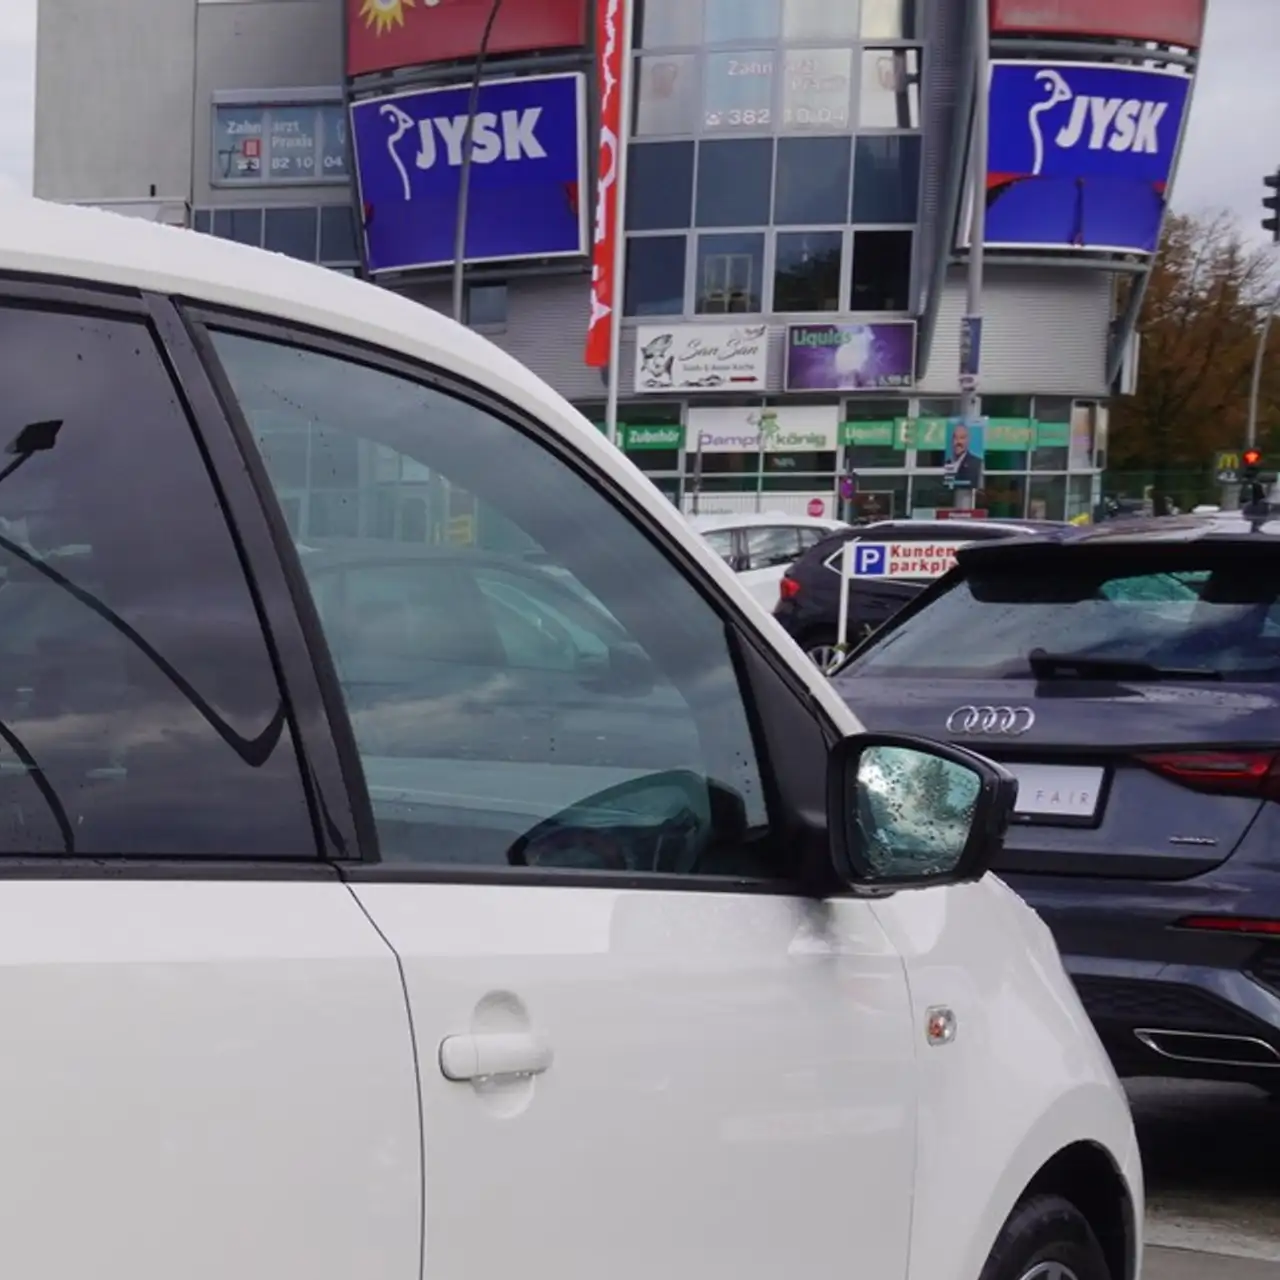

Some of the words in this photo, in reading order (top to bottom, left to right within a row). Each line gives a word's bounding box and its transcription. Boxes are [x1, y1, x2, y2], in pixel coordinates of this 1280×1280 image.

[727, 60, 773, 76] Zahn
[728, 109, 770, 125] 382
[1053, 95, 1168, 154] JYSK
[227, 121, 262, 135] Zahn
[272, 134, 313, 149] Praxis
[415, 106, 547, 170] JYSK
[793, 330, 852, 350] Liquids
[678, 337, 720, 361] San
[718, 337, 759, 361] San
[630, 429, 679, 444] Zubehör
[699, 432, 762, 449] Dampf
[775, 431, 827, 448] könig
[890, 544, 959, 558] Kunden
[861, 548, 880, 573] P
